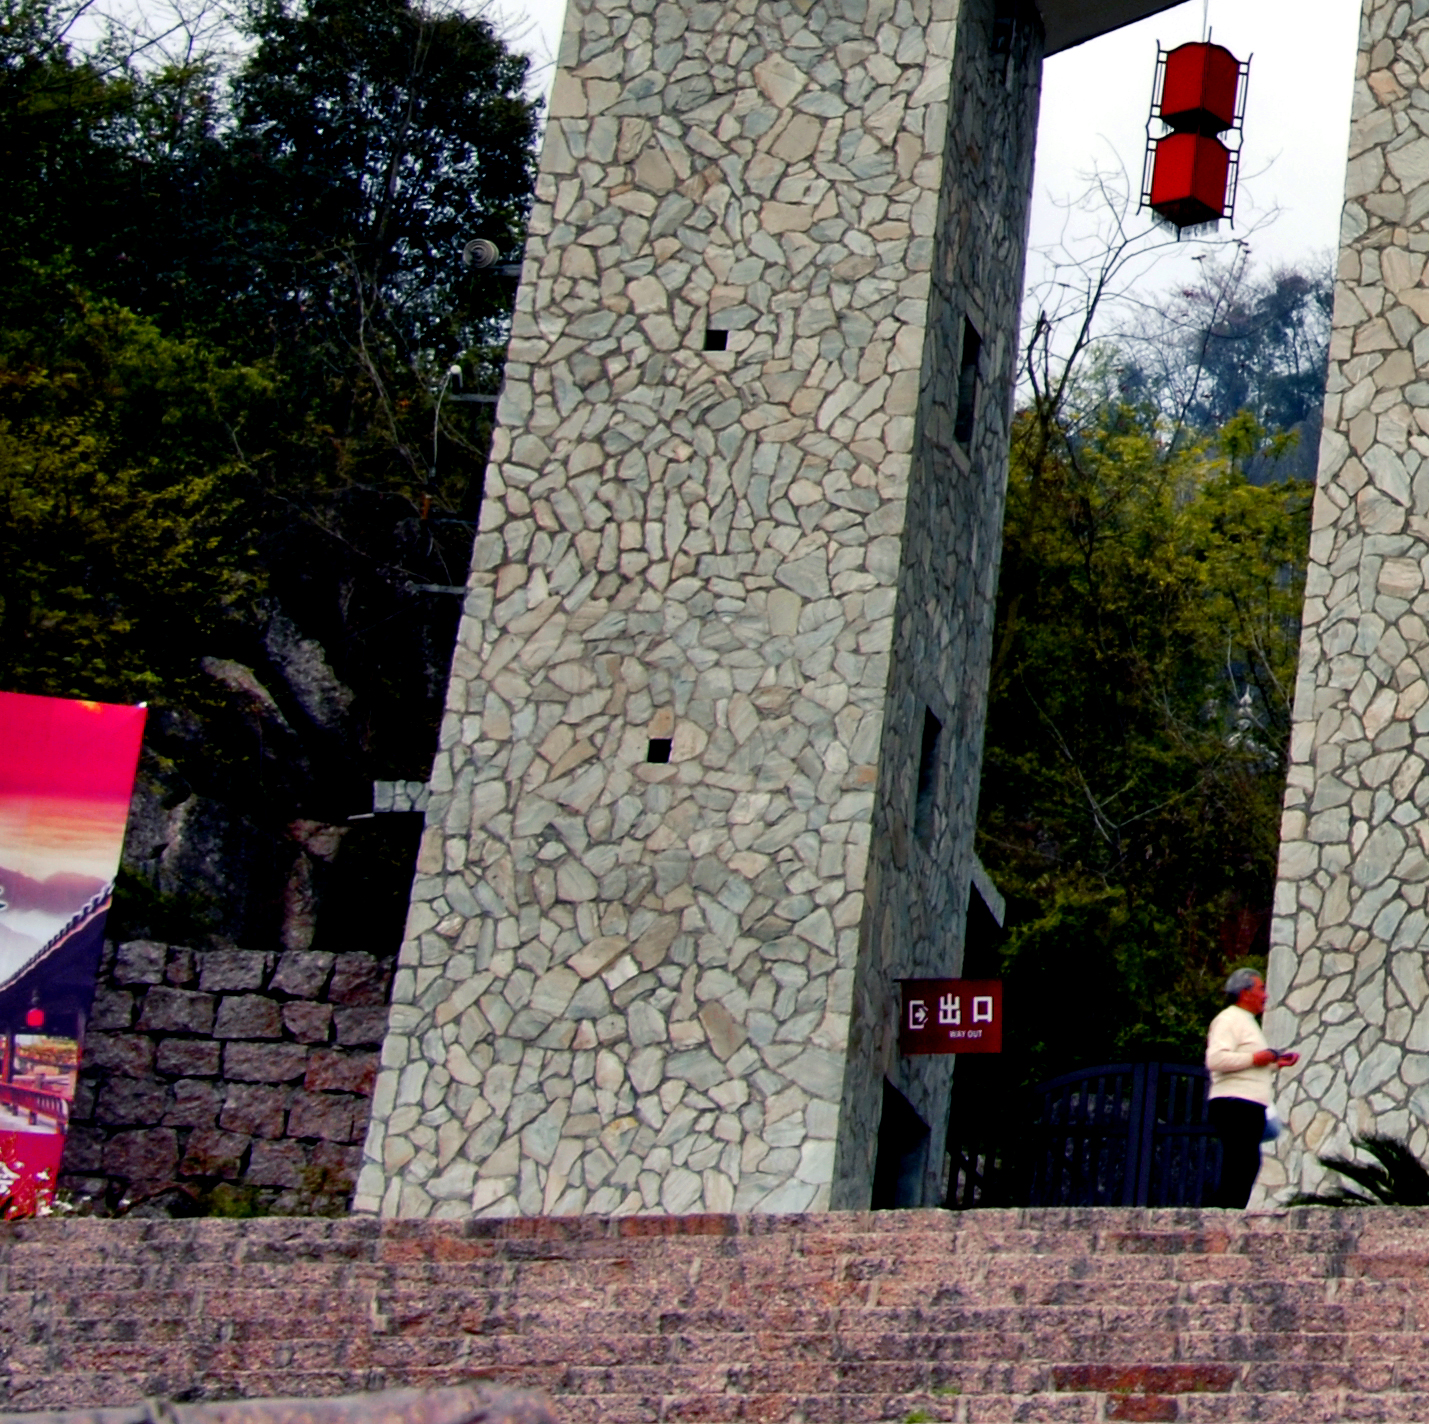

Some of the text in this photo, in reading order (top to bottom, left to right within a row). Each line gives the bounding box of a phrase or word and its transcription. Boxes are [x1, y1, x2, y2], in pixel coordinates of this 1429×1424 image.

[938, 992, 994, 1026] 出口
[949, 1029, 983, 1039] WAY OUT
